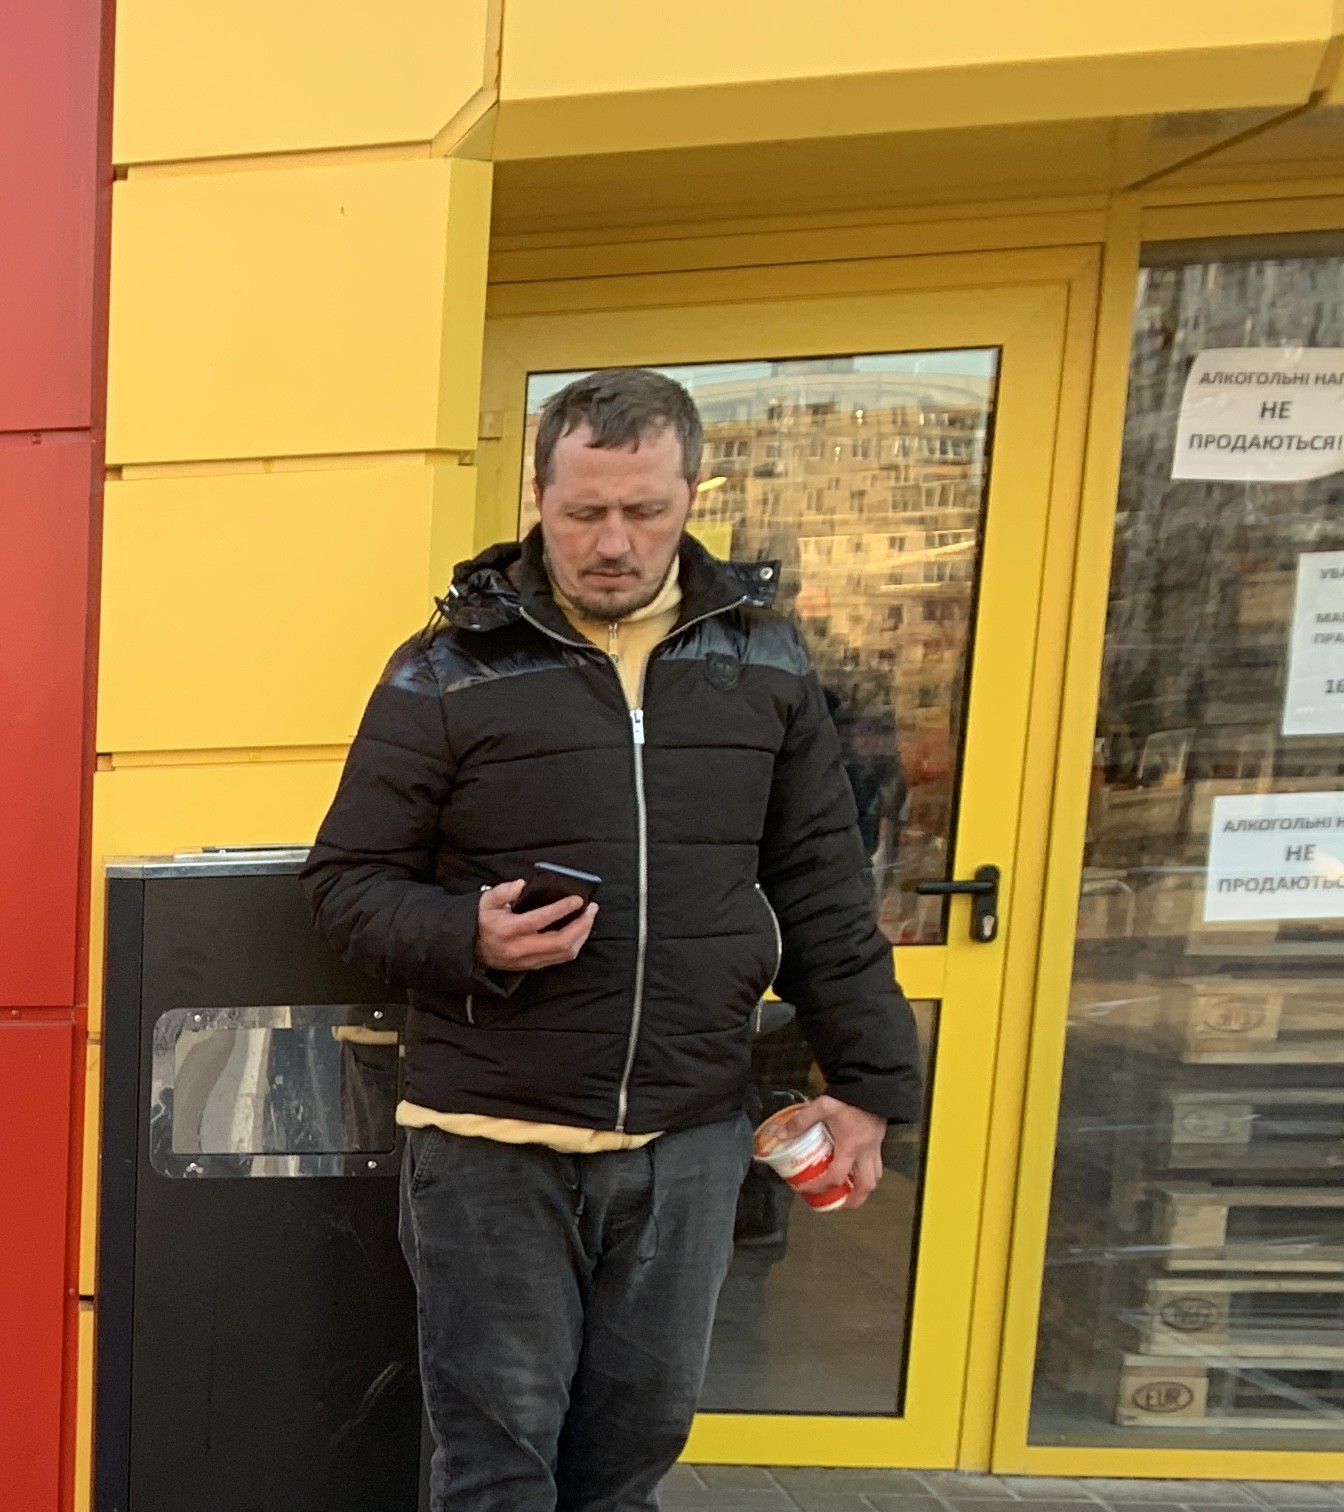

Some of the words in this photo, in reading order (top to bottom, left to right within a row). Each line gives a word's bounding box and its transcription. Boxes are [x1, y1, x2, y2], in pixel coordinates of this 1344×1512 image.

[1198, 371, 1310, 386] АЛКОГОЛЬНІ
[1259, 400, 1293, 420] НЕ
[1223, 817, 1332, 833] АЛКОГОЛЬНІ
[1285, 844, 1318, 862] НЕ
[1217, 875, 1344, 895] ПРОДАЮТЬС
